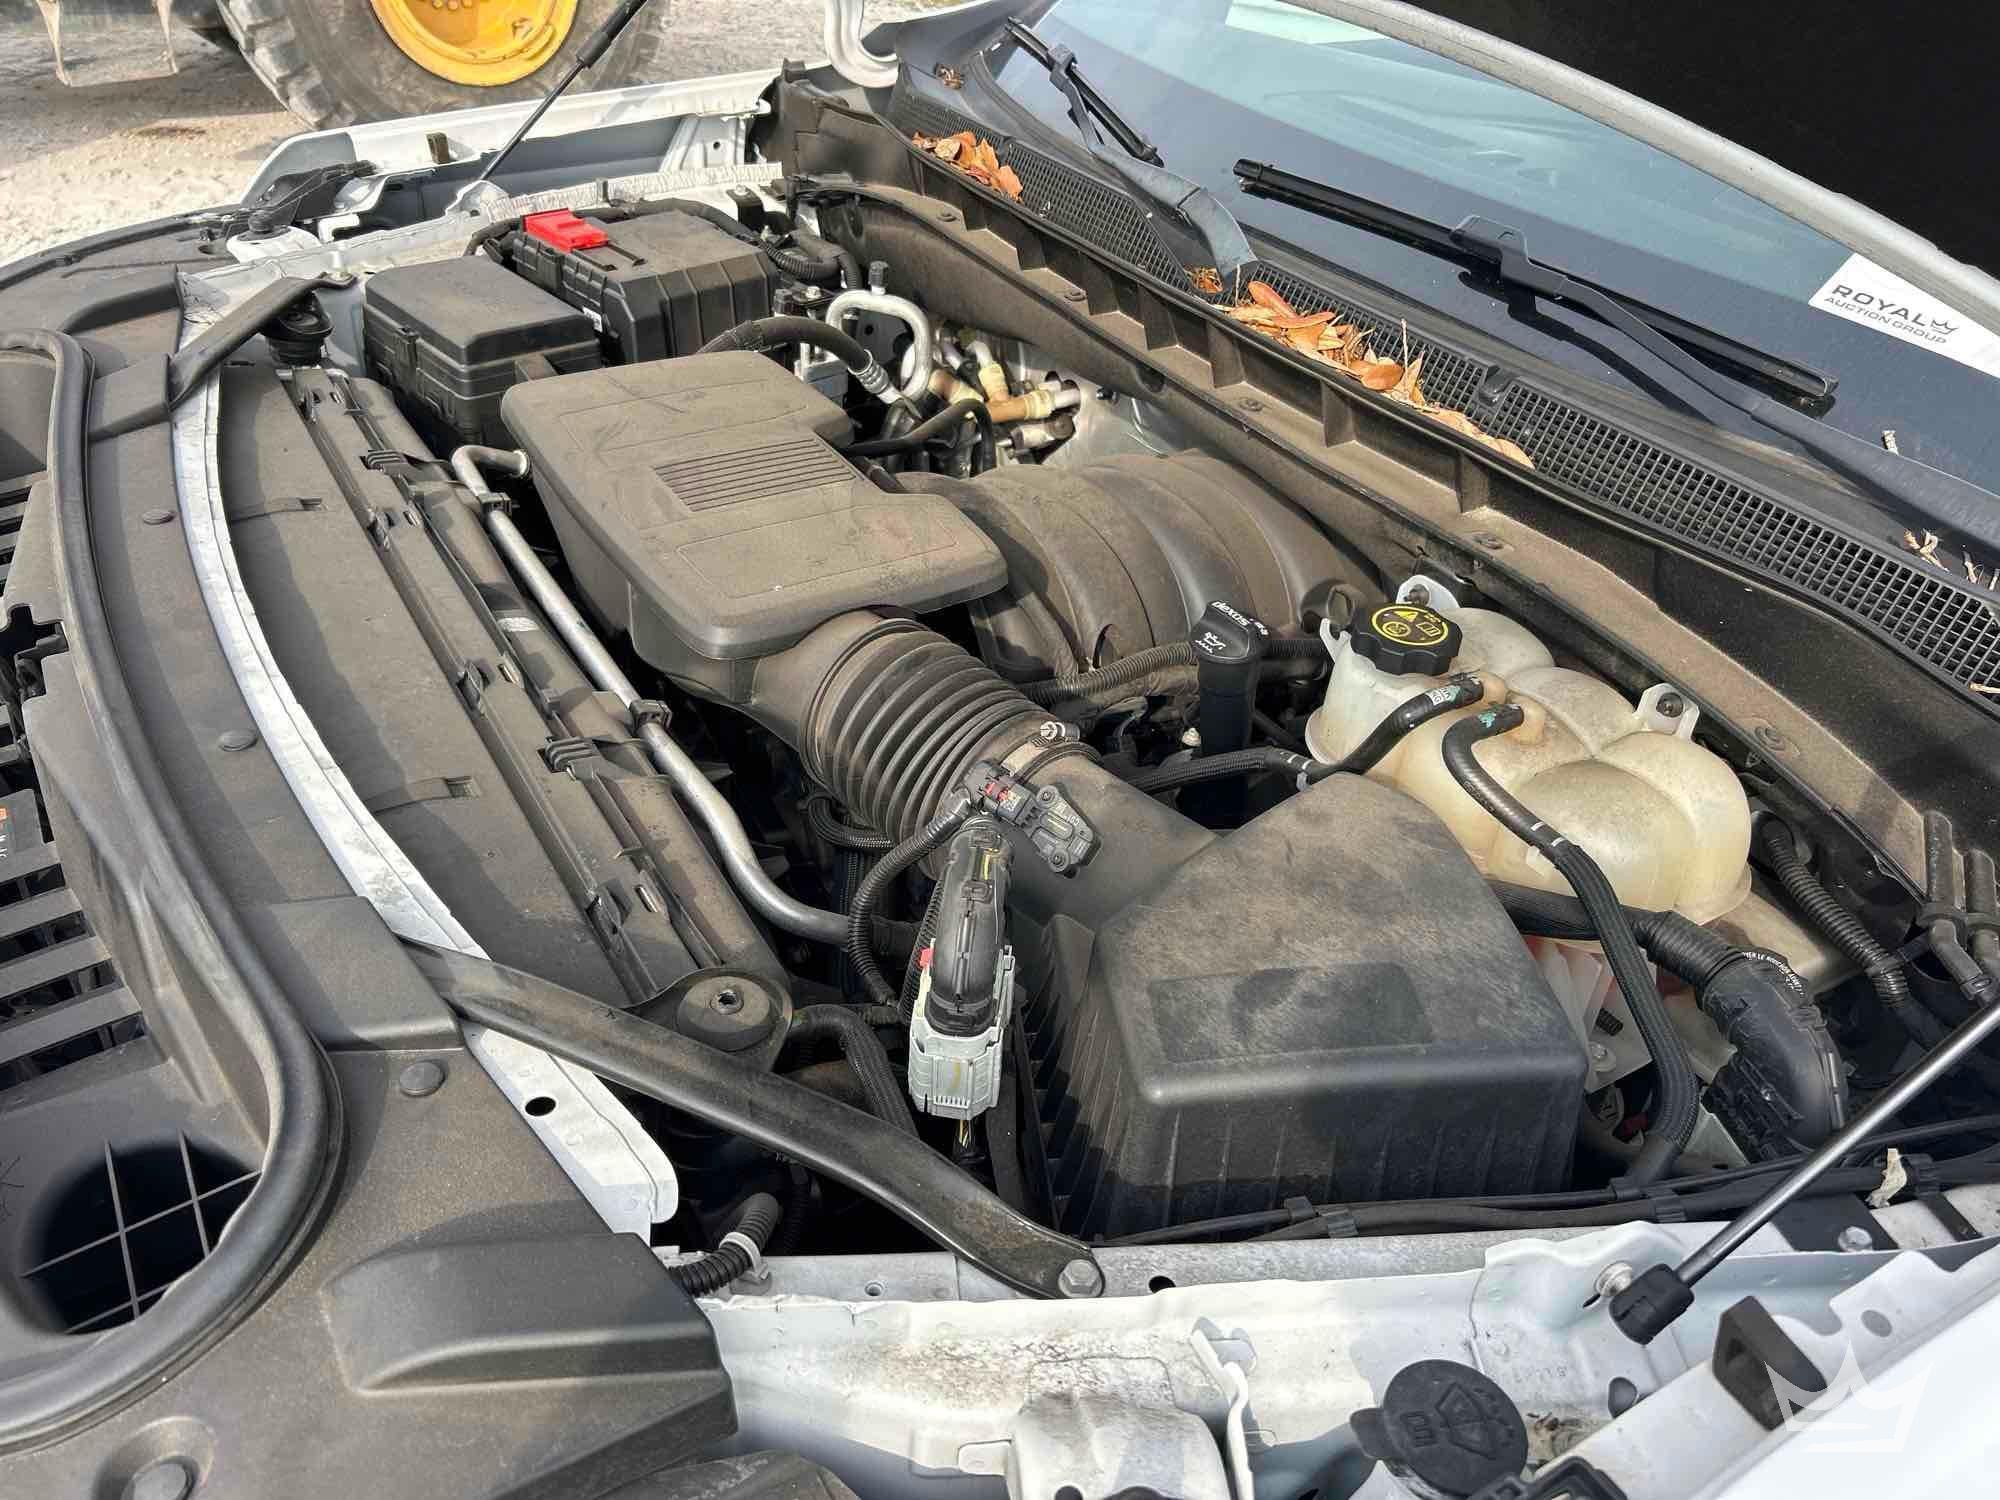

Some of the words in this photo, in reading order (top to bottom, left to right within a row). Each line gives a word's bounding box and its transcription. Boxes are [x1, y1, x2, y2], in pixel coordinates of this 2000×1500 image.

[1824, 296, 1891, 324] AUCTION
[1892, 320, 1948, 344] GROUP
[1831, 284, 1927, 327] ROYAL
